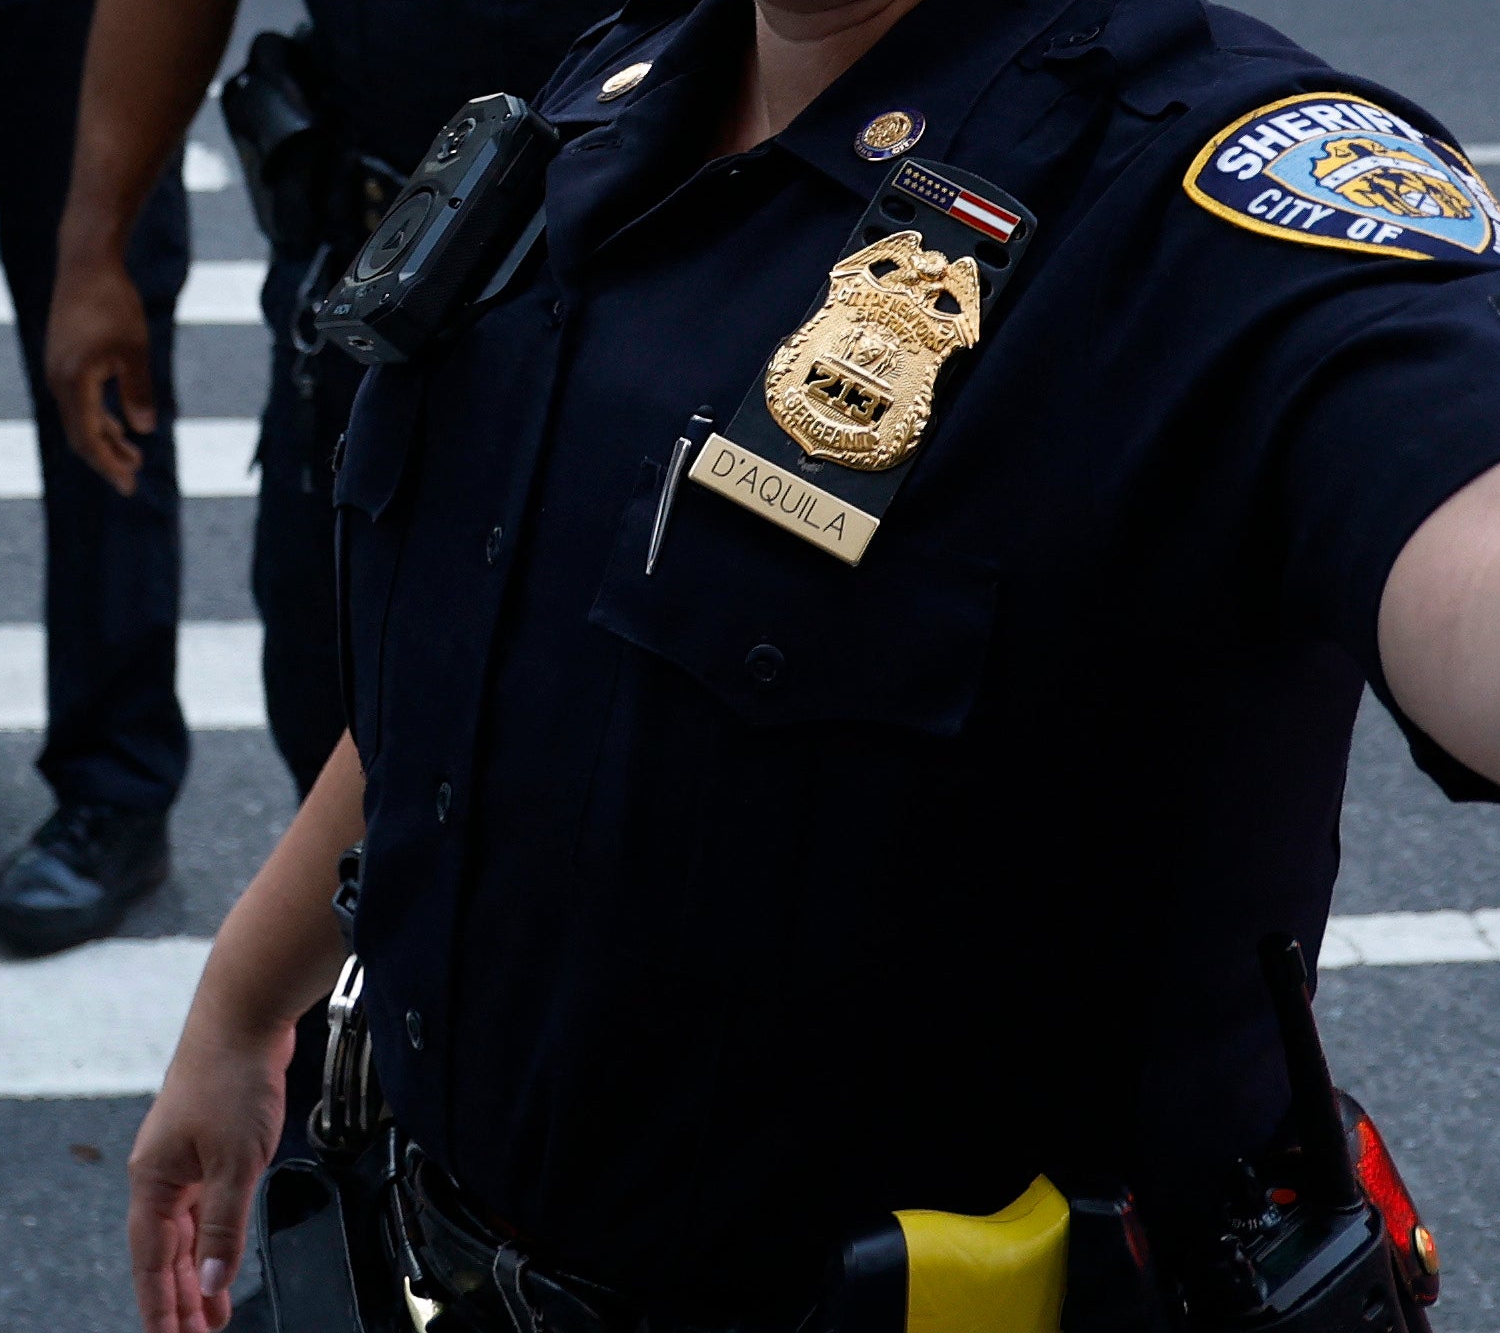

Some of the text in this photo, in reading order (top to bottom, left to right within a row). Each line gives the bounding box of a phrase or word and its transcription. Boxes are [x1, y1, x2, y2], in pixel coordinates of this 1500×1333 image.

[1216, 102, 1423, 180] SHERIFF
[1247, 188, 1404, 244] CITY OF
[785, 394, 869, 451] SERGEANT
[807, 364, 881, 425] 213
[711, 449, 846, 541] D'AQUILA
